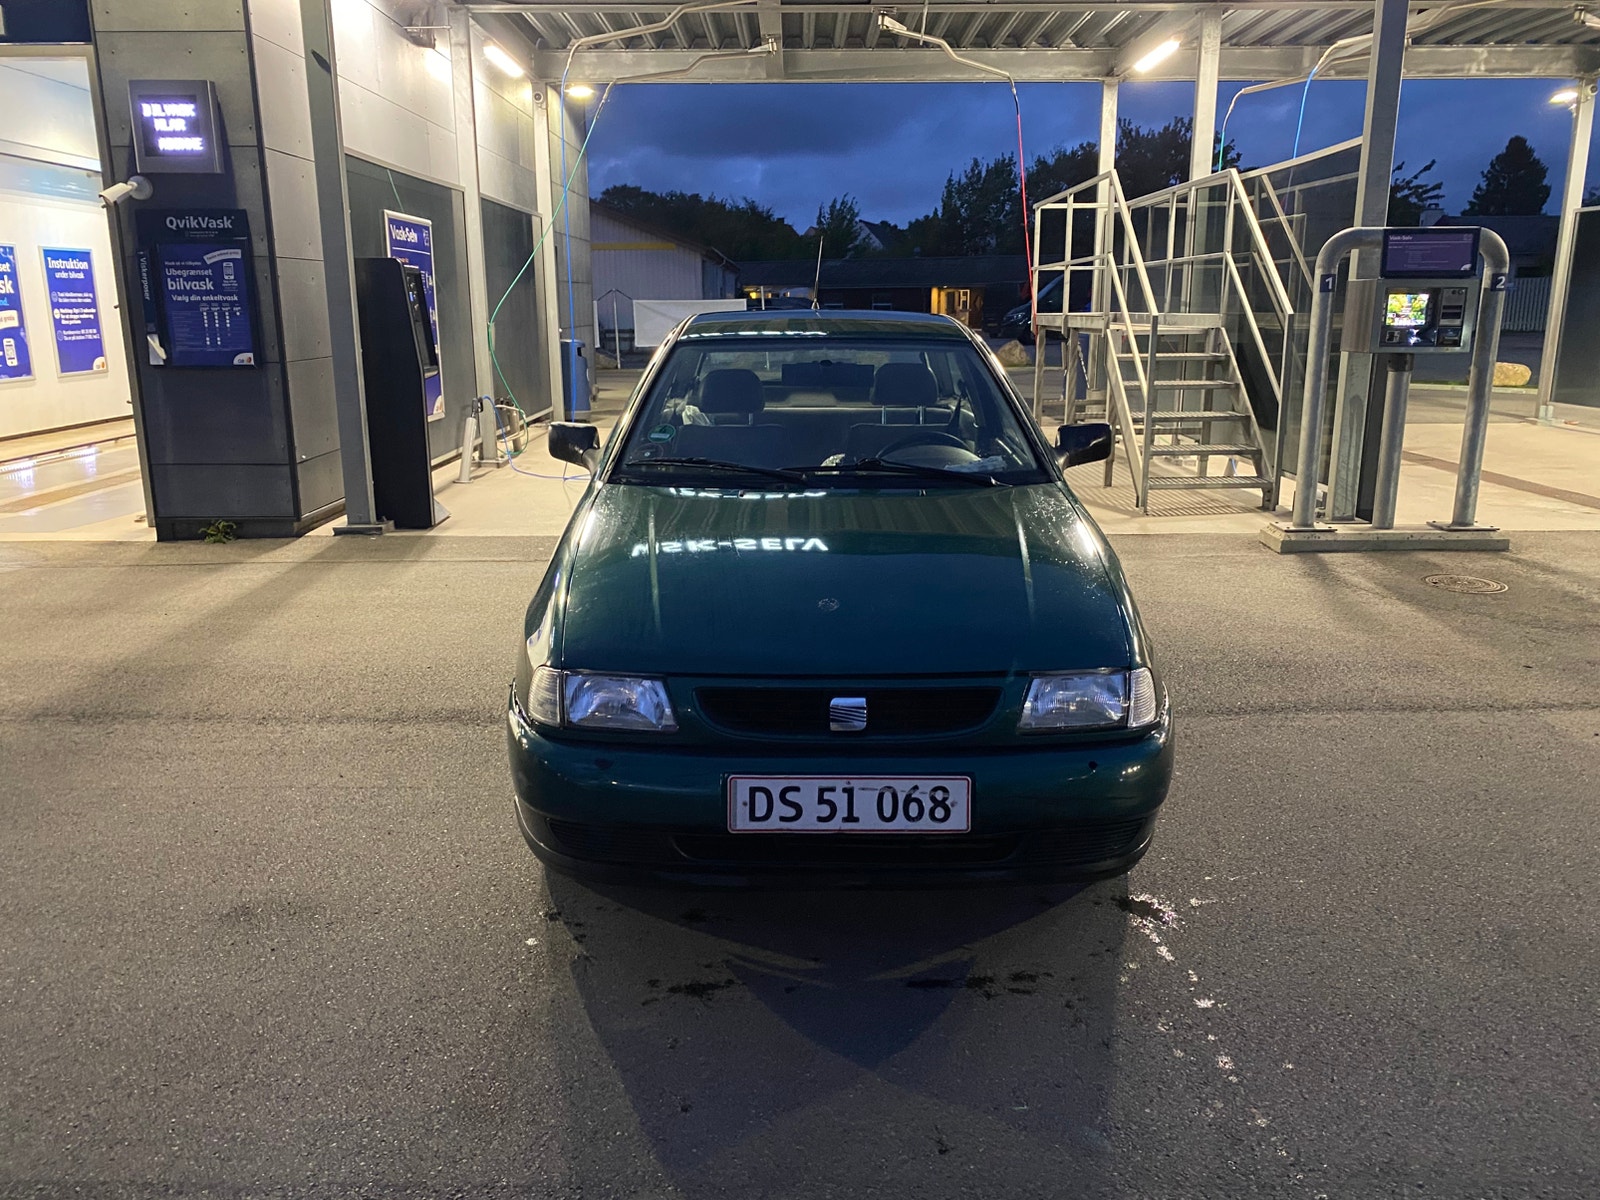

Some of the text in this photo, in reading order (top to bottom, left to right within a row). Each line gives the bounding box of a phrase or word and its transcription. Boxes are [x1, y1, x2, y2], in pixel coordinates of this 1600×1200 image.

[166, 215, 233, 230] QvikVask
[47, 256, 89, 269] Instruktion
[141, 257, 150, 300] Viskerposer
[165, 268, 213, 277] Ubegrænset
[167, 277, 215, 290] bilvask
[1325, 277, 1333, 289] 1
[1496, 276, 1506, 289] 2
[172, 294, 189, 302] Vælg
[748, 784, 952, 823] DS 51 068
